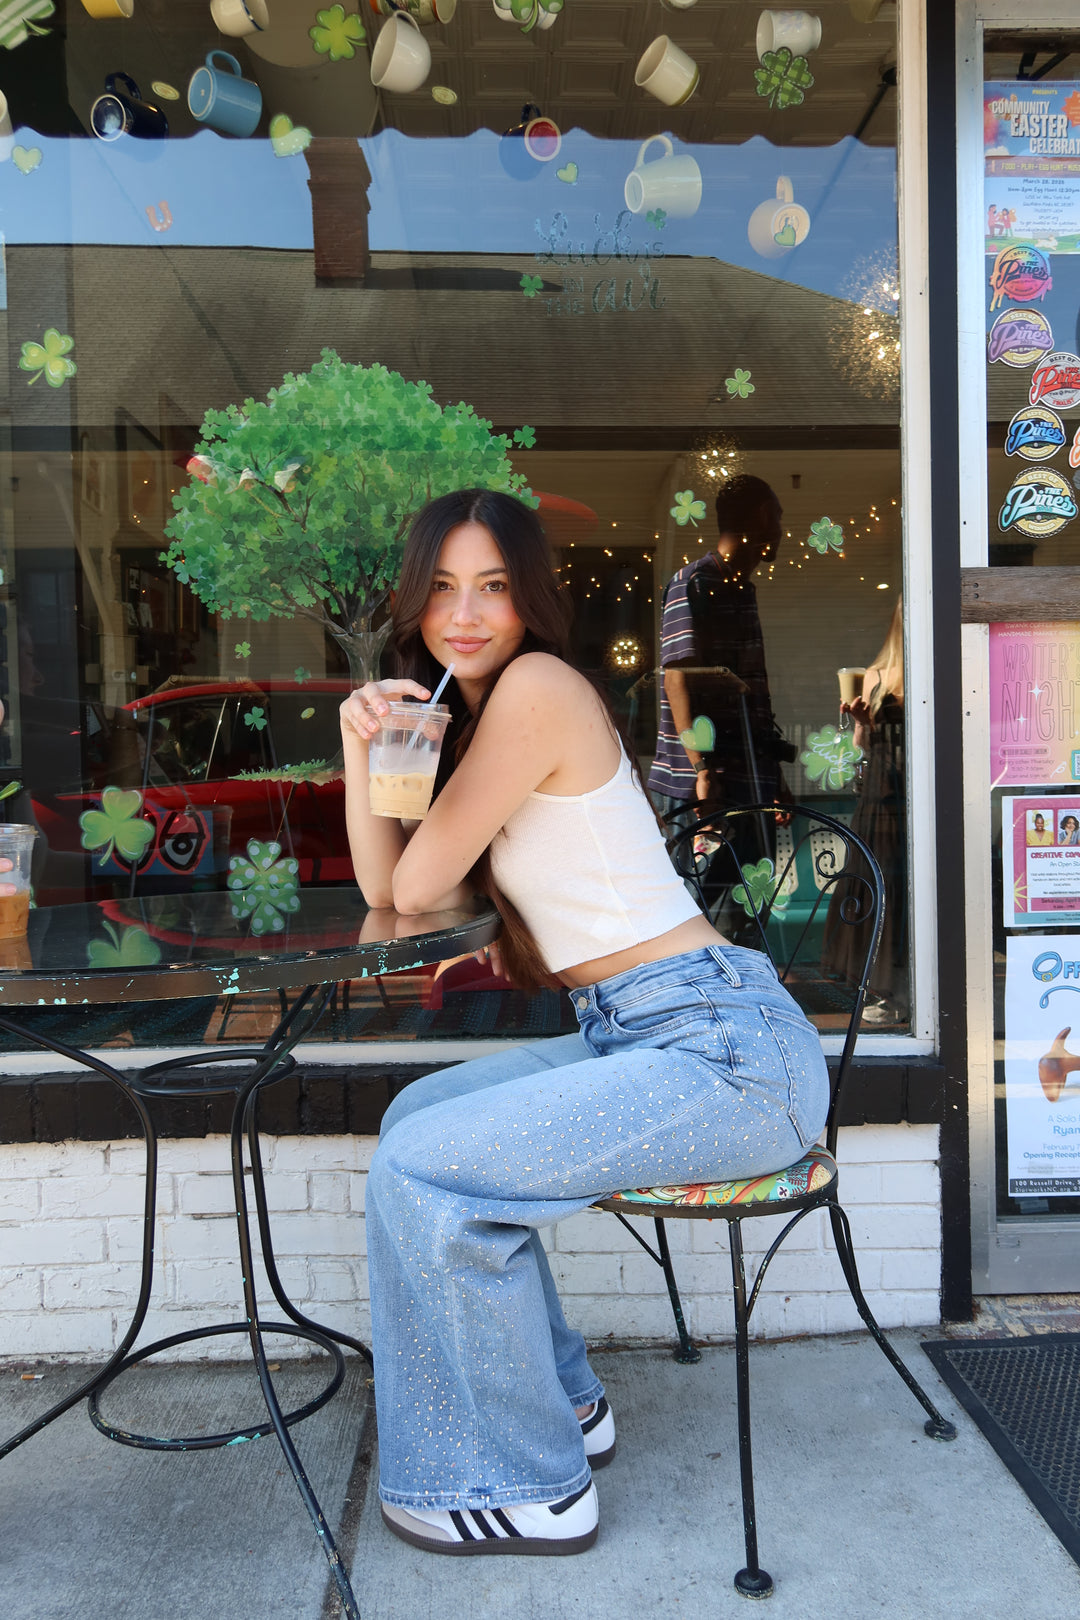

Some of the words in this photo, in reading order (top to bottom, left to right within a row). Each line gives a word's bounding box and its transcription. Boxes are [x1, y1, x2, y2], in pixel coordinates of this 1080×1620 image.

[991, 100, 1050, 114] COMMUNITY
[1010, 114, 1068, 138] EASTER
[995, 258, 1049, 290] Pines
[562, 277, 585, 295] IN
[543, 297, 585, 316] THE
[1009, 312, 1027, 321] BEST
[1027, 313, 1037, 321] OF
[990, 320, 1053, 360] Pines
[1052, 397, 1075, 405] FINALIST
[1007, 419, 1064, 453] Pines
[1026, 473, 1047, 482] BEST
[1048, 474, 1059, 483] OF
[1044, 487, 1063, 495] THE
[1001, 483, 1077, 528] Pines
[1047, 1115, 1055, 1123] A
[1056, 1114, 1077, 1123] Solo
[1053, 1125, 1080, 1137] Ryan
[1043, 1143, 1075, 1152] February
[1023, 1152, 1054, 1160] Opening
